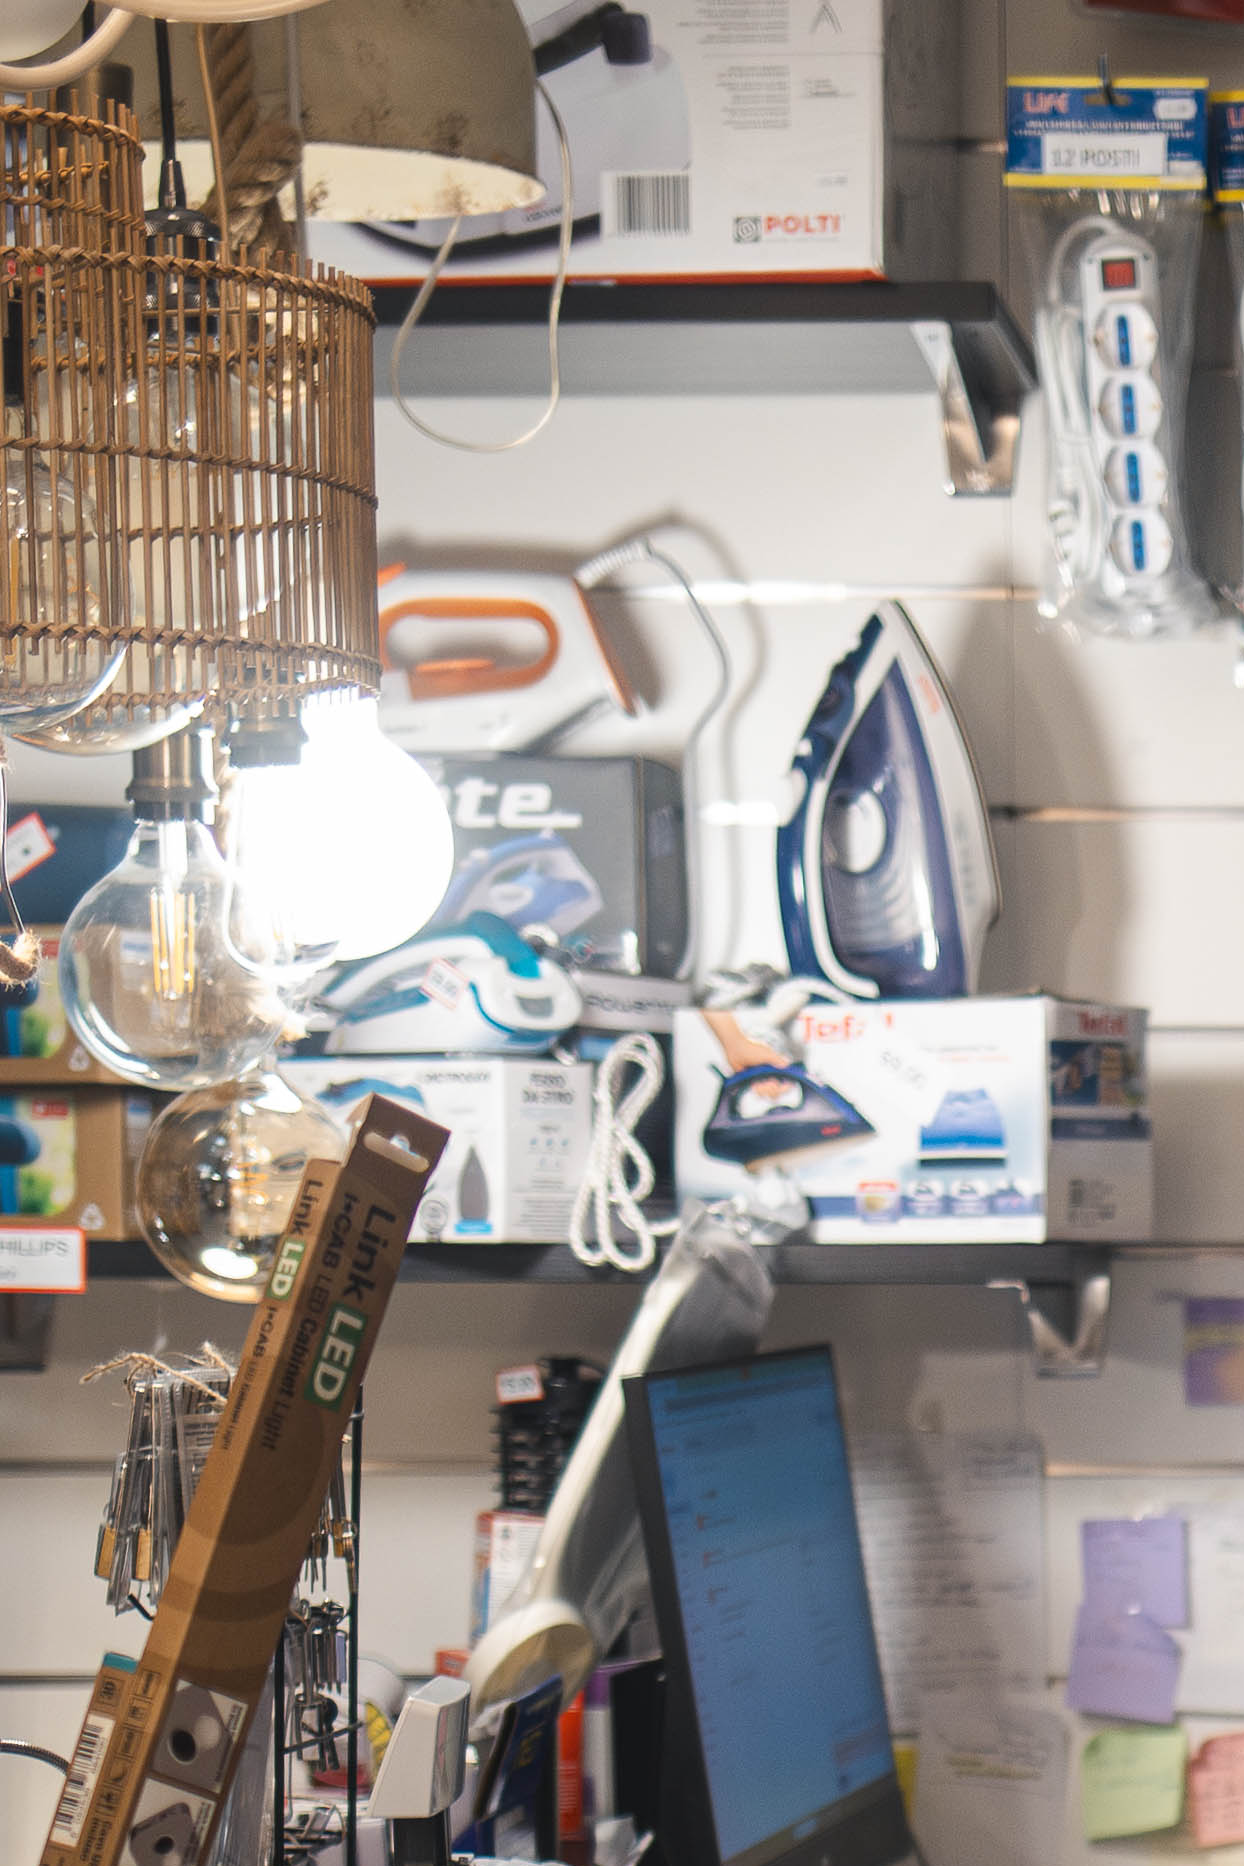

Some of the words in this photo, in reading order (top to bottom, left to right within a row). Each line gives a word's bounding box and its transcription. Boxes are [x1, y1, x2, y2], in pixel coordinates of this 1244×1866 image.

[763, 213, 841, 234] POLTI
[796, 1012, 896, 1043] Tefl
[289, 1178, 323, 1238] Link
[0, 1237, 72, 1256] HILLIPS
[268, 1239, 304, 1298] LED
[340, 1202, 398, 1304] Link
[276, 1315, 321, 1399] Cabinet
[307, 1307, 366, 1405] LED
[256, 1397, 293, 1453] Light
